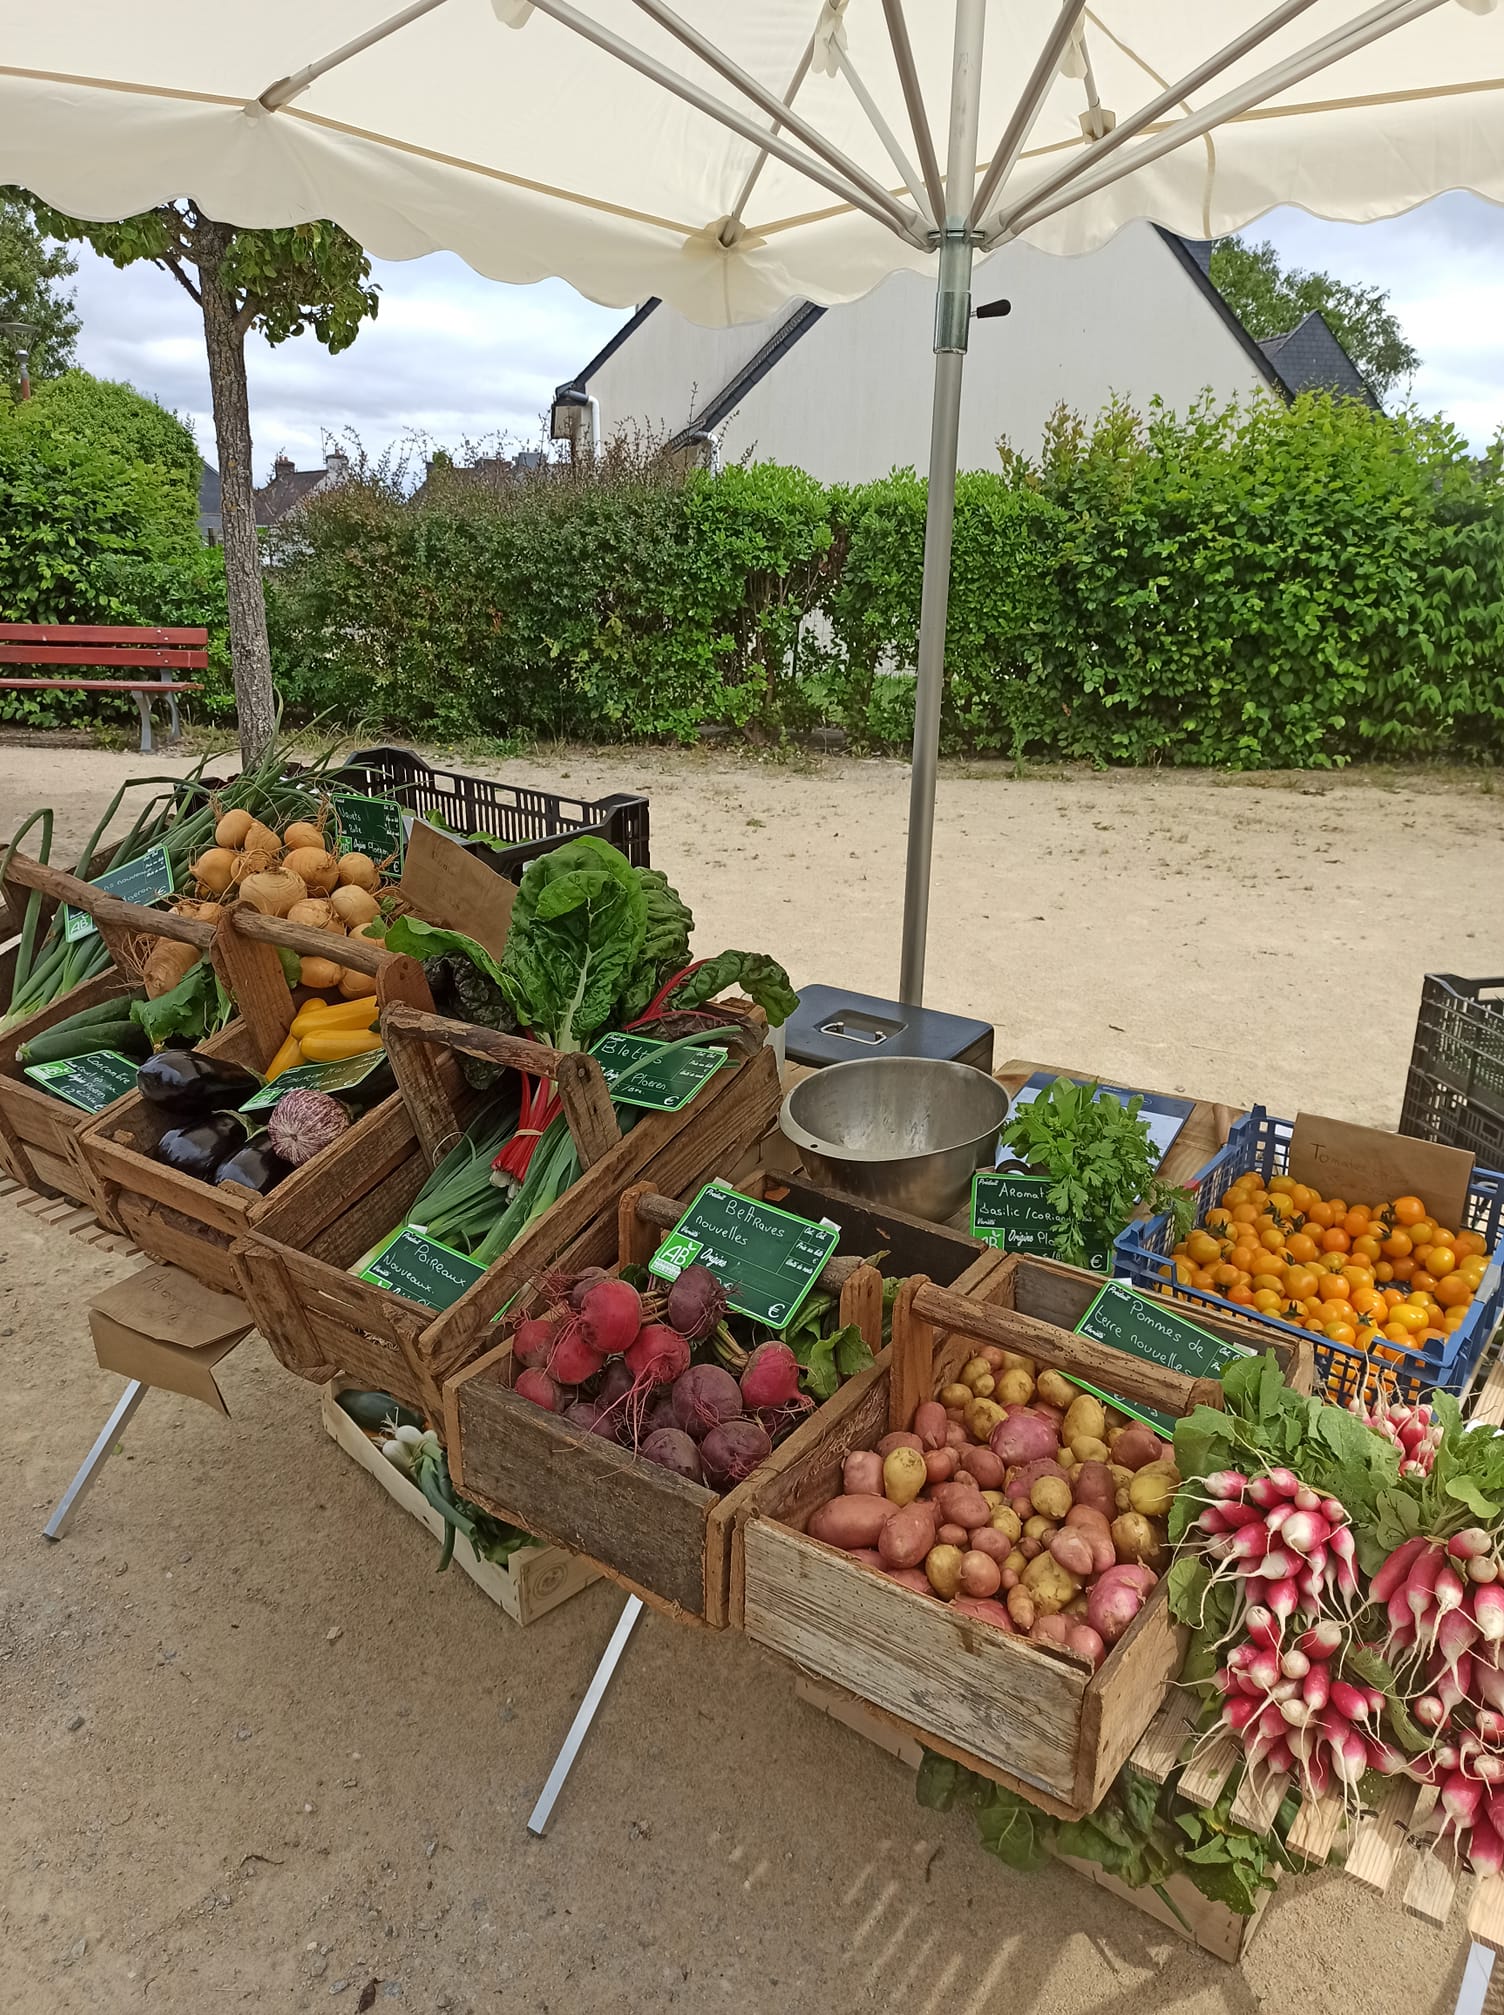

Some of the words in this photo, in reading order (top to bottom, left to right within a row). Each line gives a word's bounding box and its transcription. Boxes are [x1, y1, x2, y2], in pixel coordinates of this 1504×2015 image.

[695, 1215, 749, 1246] nouvelles
[660, 1245, 690, 1266] AB
[1090, 1254, 1103, 1269] €
[767, 1303, 786, 1319] €
[1094, 1304, 1123, 1339] terre
[1129, 1300, 1182, 1342] Pommes
[1188, 1339, 1204, 1360] de
